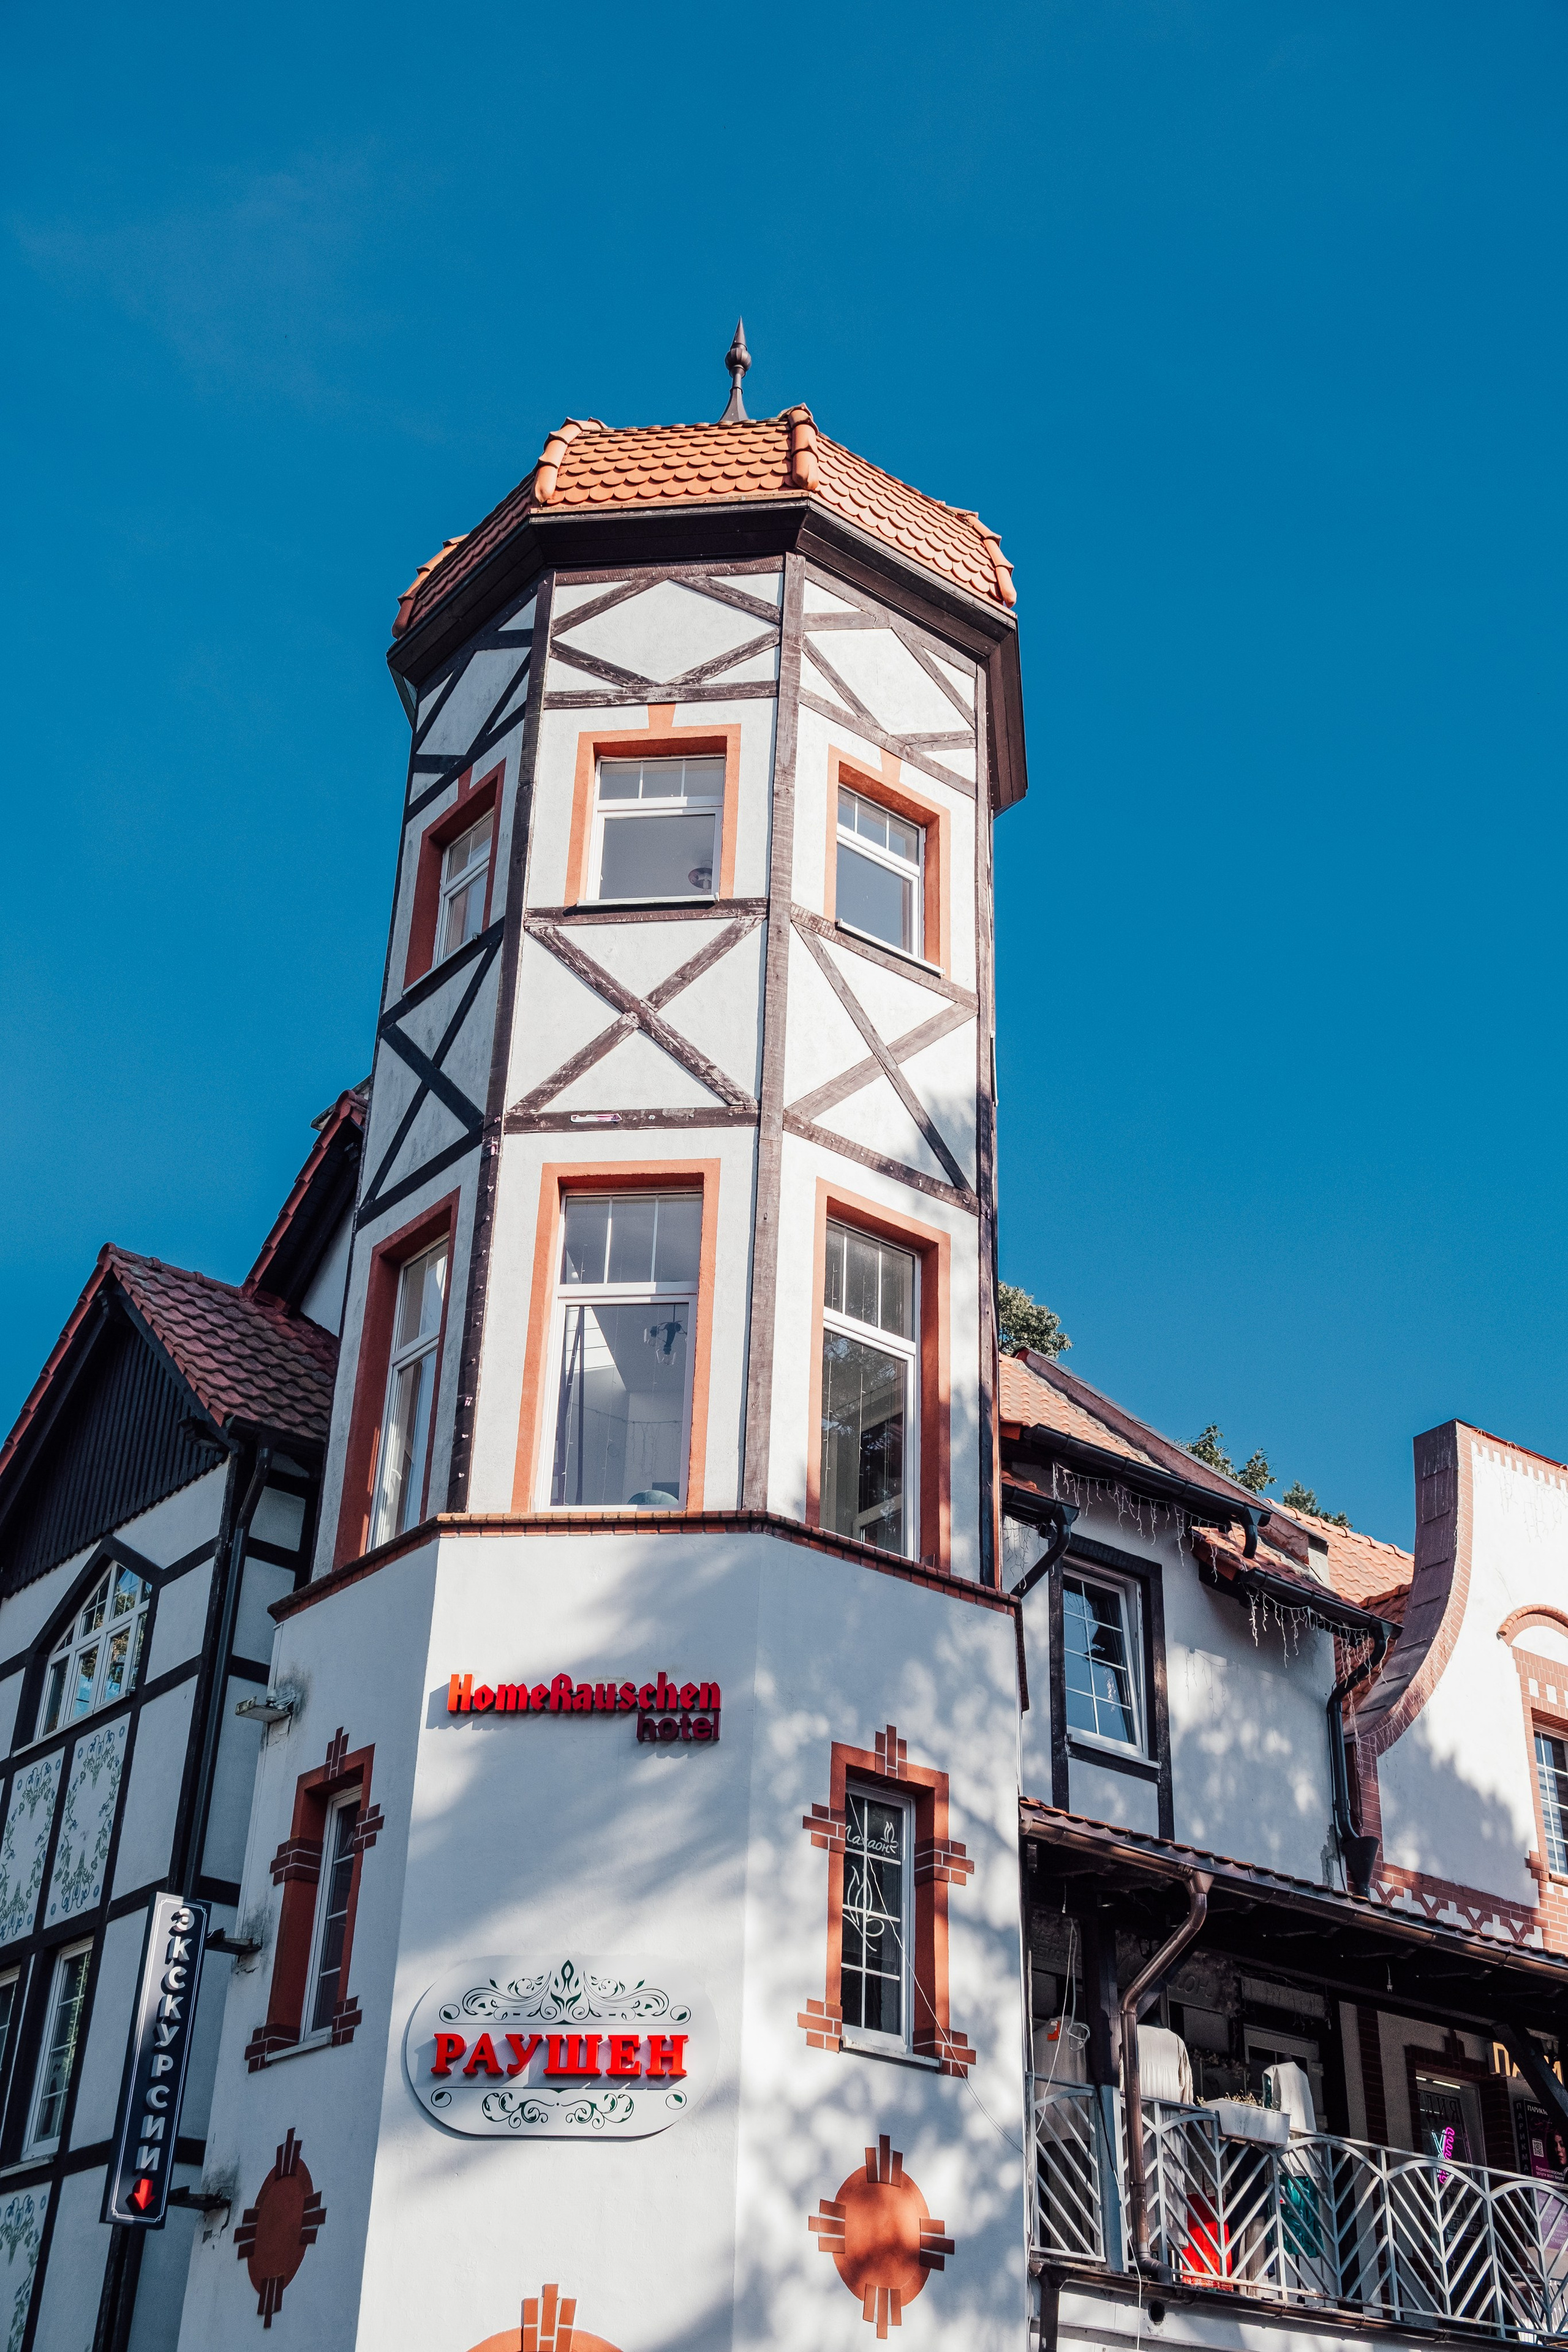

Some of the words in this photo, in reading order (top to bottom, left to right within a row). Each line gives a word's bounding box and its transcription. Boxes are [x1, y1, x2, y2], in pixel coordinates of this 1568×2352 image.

[447, 1672, 721, 1713] HomeRauschen
[636, 1711, 720, 1742] hotel
[137, 1907, 195, 2171] ЭКСКУРСИИ
[431, 2032, 689, 2076] РАУШЕН
